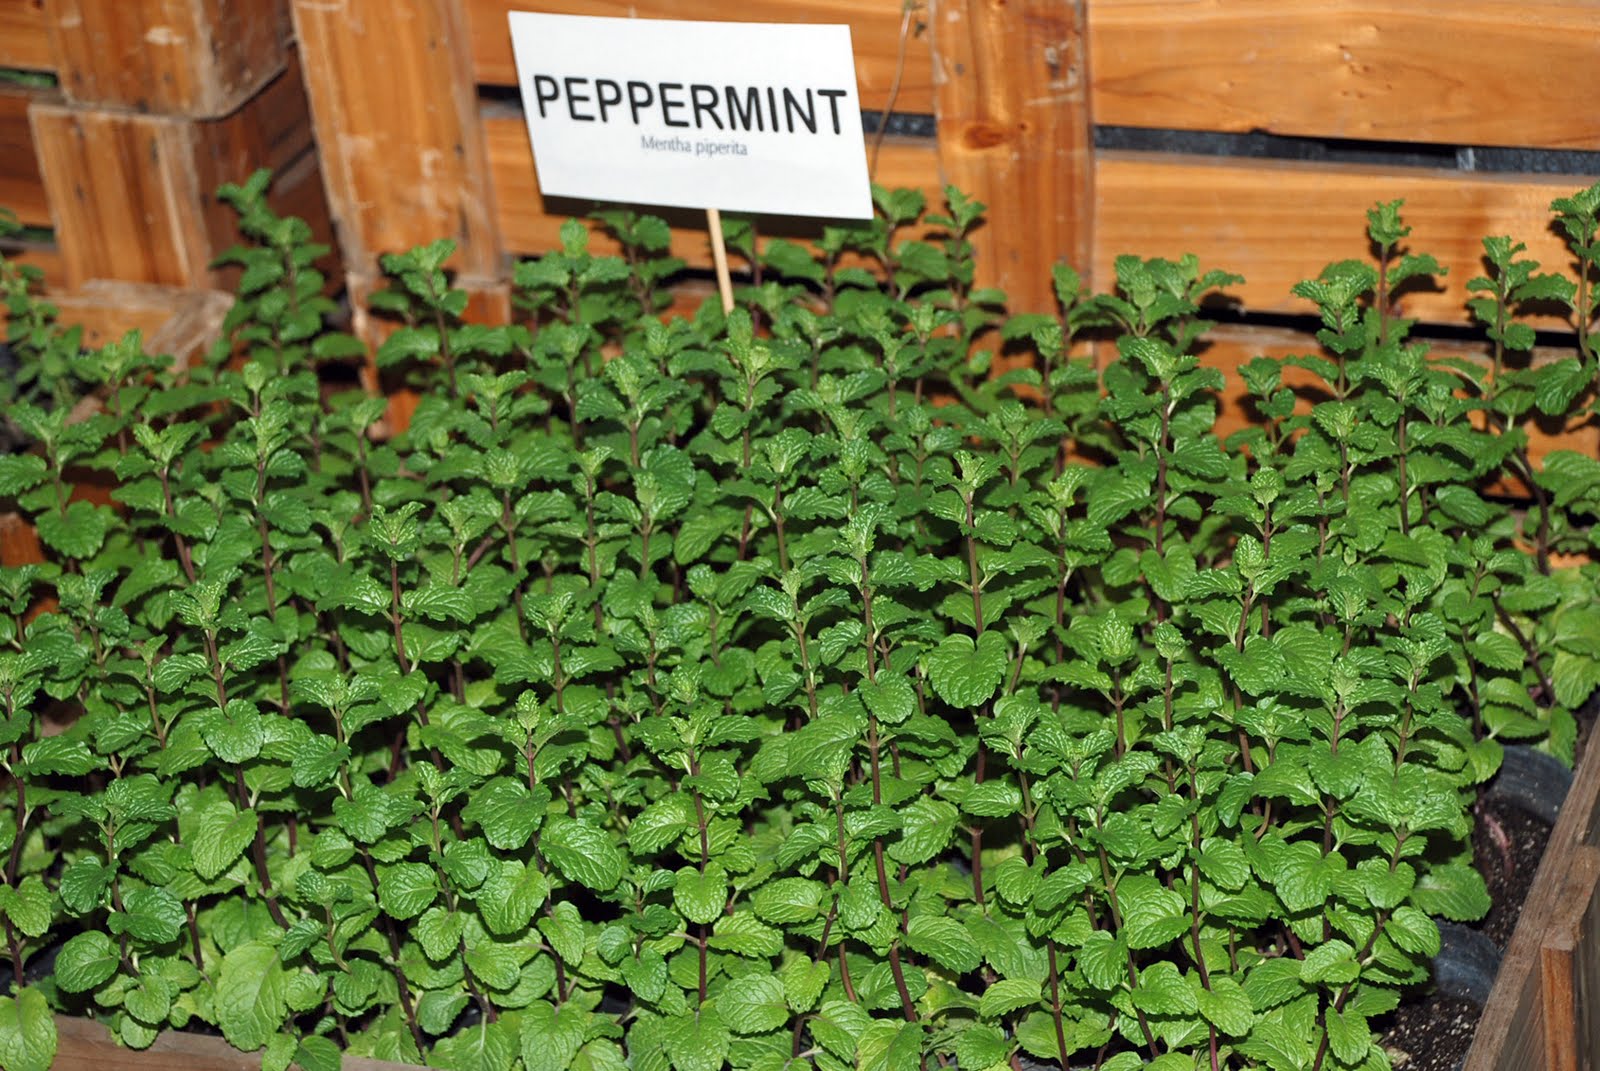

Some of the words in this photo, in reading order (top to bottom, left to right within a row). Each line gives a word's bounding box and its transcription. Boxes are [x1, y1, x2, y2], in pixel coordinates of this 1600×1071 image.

[533, 74, 847, 135] PEPPERMINT
[641, 135, 692, 152] Mentha
[695, 139, 748, 157] piperita
